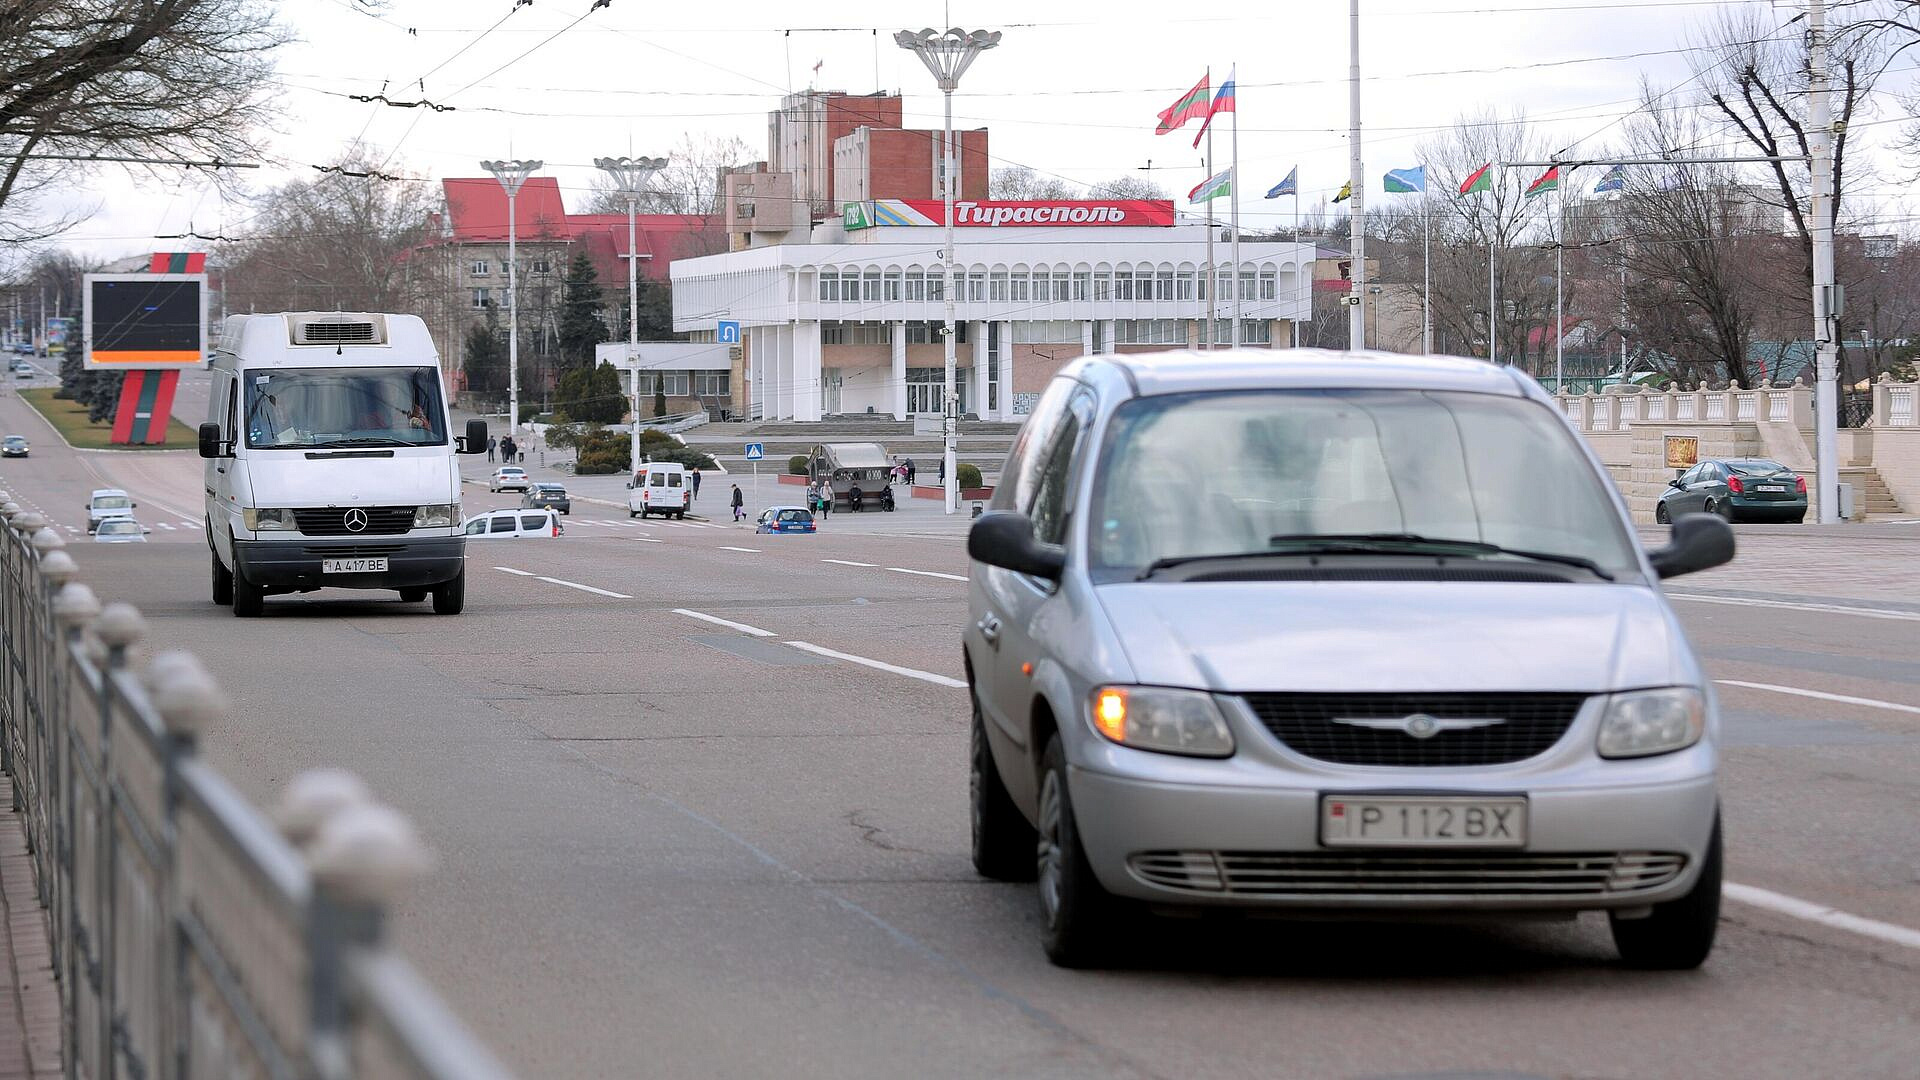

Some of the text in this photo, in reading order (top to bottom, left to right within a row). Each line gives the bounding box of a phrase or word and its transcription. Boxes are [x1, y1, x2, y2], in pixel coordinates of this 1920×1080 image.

[955, 201, 1125, 226] Тирасполь
[345, 560, 365, 571] 417
[369, 560, 385, 571] BE
[1399, 807, 1454, 837] 112
[1465, 806, 1511, 837] BX
